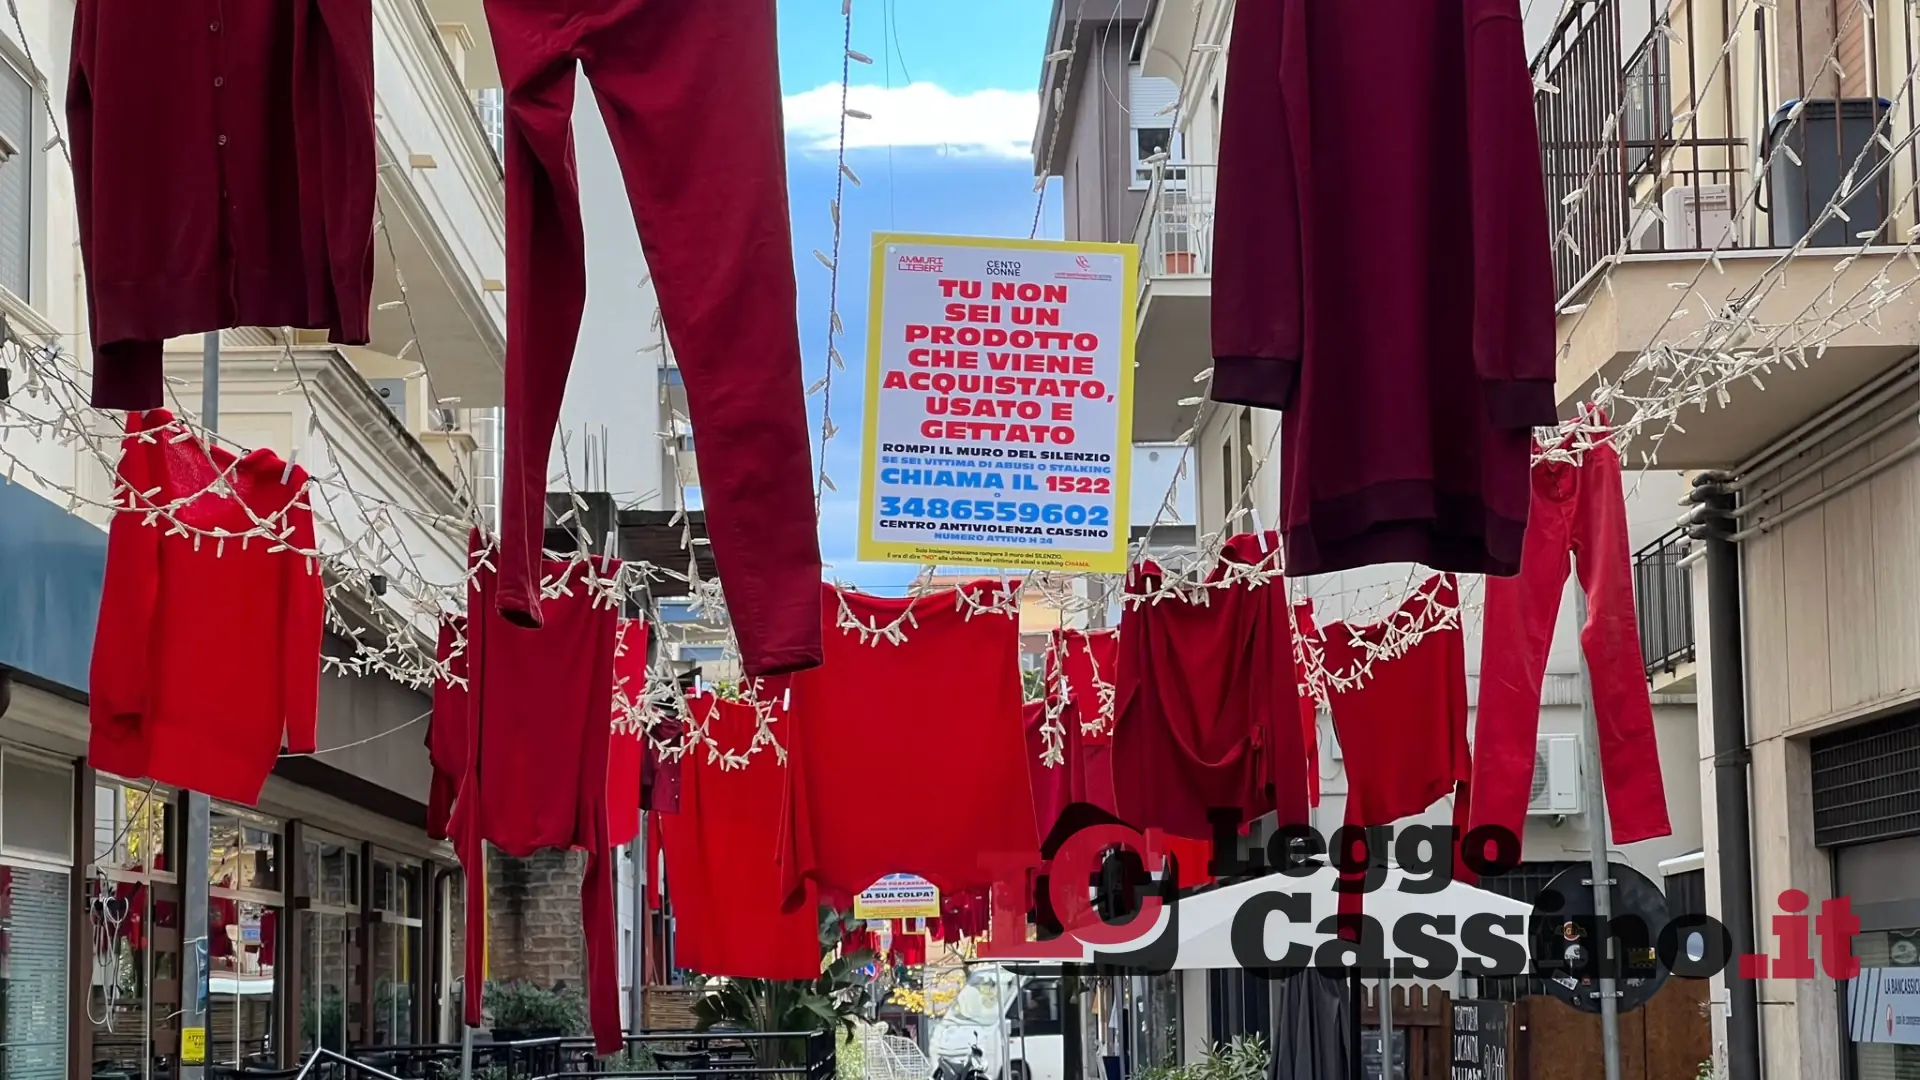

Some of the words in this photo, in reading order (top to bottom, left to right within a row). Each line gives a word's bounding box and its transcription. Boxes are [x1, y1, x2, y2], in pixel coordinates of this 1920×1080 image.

[986, 268, 1021, 277] DONNE
[987, 260, 1021, 269] CENTO
[938, 279, 982, 299] TU
[991, 282, 1067, 304] NON
[945, 303, 1000, 323] SEI
[1011, 306, 1059, 326] UN
[905, 325, 1098, 352] PRODOTTO
[908, 349, 979, 370] CHE
[987, 352, 1093, 375] VIENE
[883, 371, 1114, 403] ACQUISTATO,
[925, 396, 1041, 420] USATO
[1052, 403, 1072, 421] E
[920, 420, 1075, 445] GETTATO
[882, 443, 935, 454] ROMPI
[940, 446, 953, 455] IL
[957, 447, 1003, 457] MURO
[1007, 449, 1037, 459] DEL
[1040, 451, 1111, 463] SILENZIO
[882, 455, 898, 465] SE
[901, 456, 921, 466] SEI
[924, 457, 975, 468] VITTIMA
[979, 460, 992, 468] DI
[995, 461, 1034, 470] ABUSI
[1038, 463, 1046, 471] O
[1049, 463, 1111, 474] STALKING
[881, 468, 1004, 490] CHIAMA
[1012, 474, 1038, 491] IL
[1045, 476, 1110, 494] 1522
[880, 496, 1109, 526] 3486559602
[879, 520, 936, 531] CENTRO
[939, 522, 1043, 535] ANTIVIOLENZA
[1046, 527, 1108, 538] CASSINO
[934, 532, 983, 542] NUMERO
[986, 535, 1026, 544] ATTIVO
[1884, 978, 1890, 995] LA
